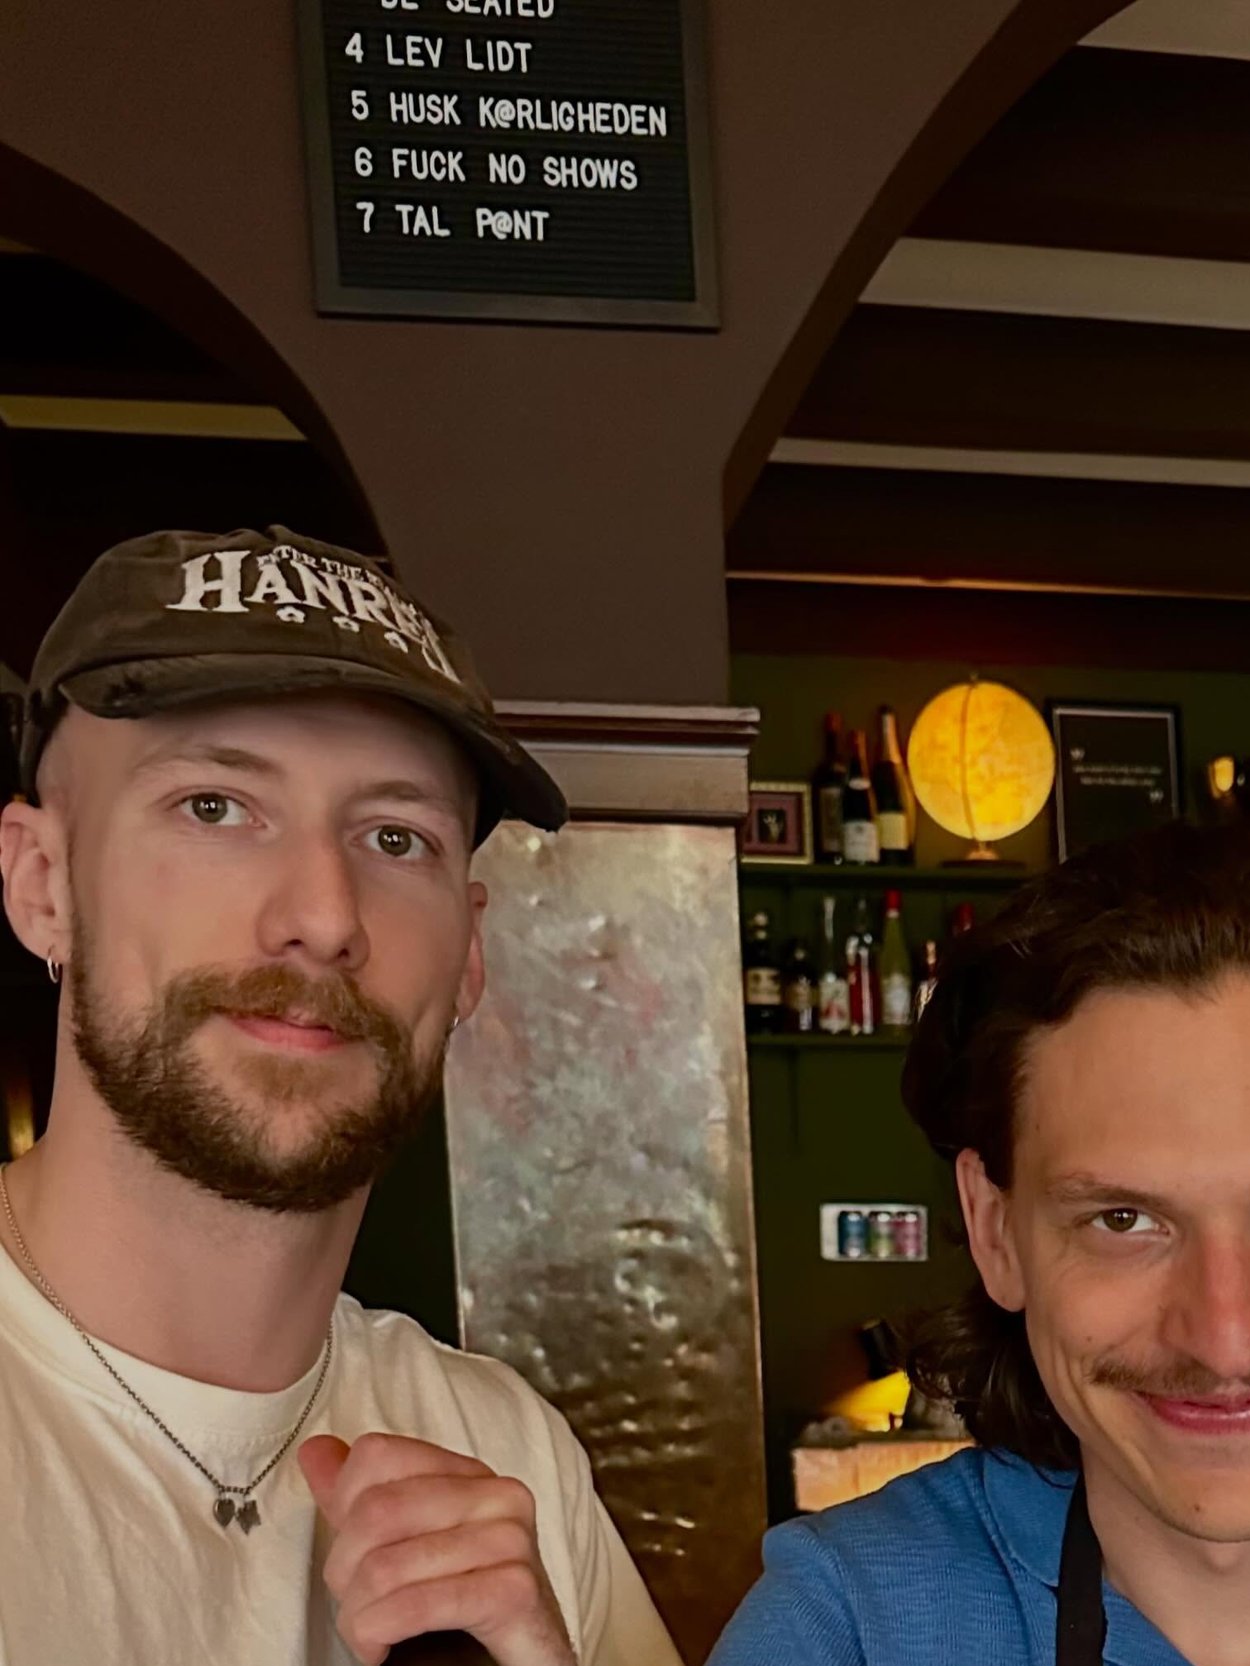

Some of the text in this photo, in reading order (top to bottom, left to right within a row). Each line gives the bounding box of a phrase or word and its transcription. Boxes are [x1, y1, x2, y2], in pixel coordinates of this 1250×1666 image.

[345, 33, 532, 73] 4 LEV LIDT
[351, 90, 667, 136] 5 HUSK K@RLIGHEDEN
[354, 147, 638, 190] 6 FUCK NO SHOWS
[356, 202, 549, 241] 7 TAL P@NT
[321, 557, 364, 583] THE
